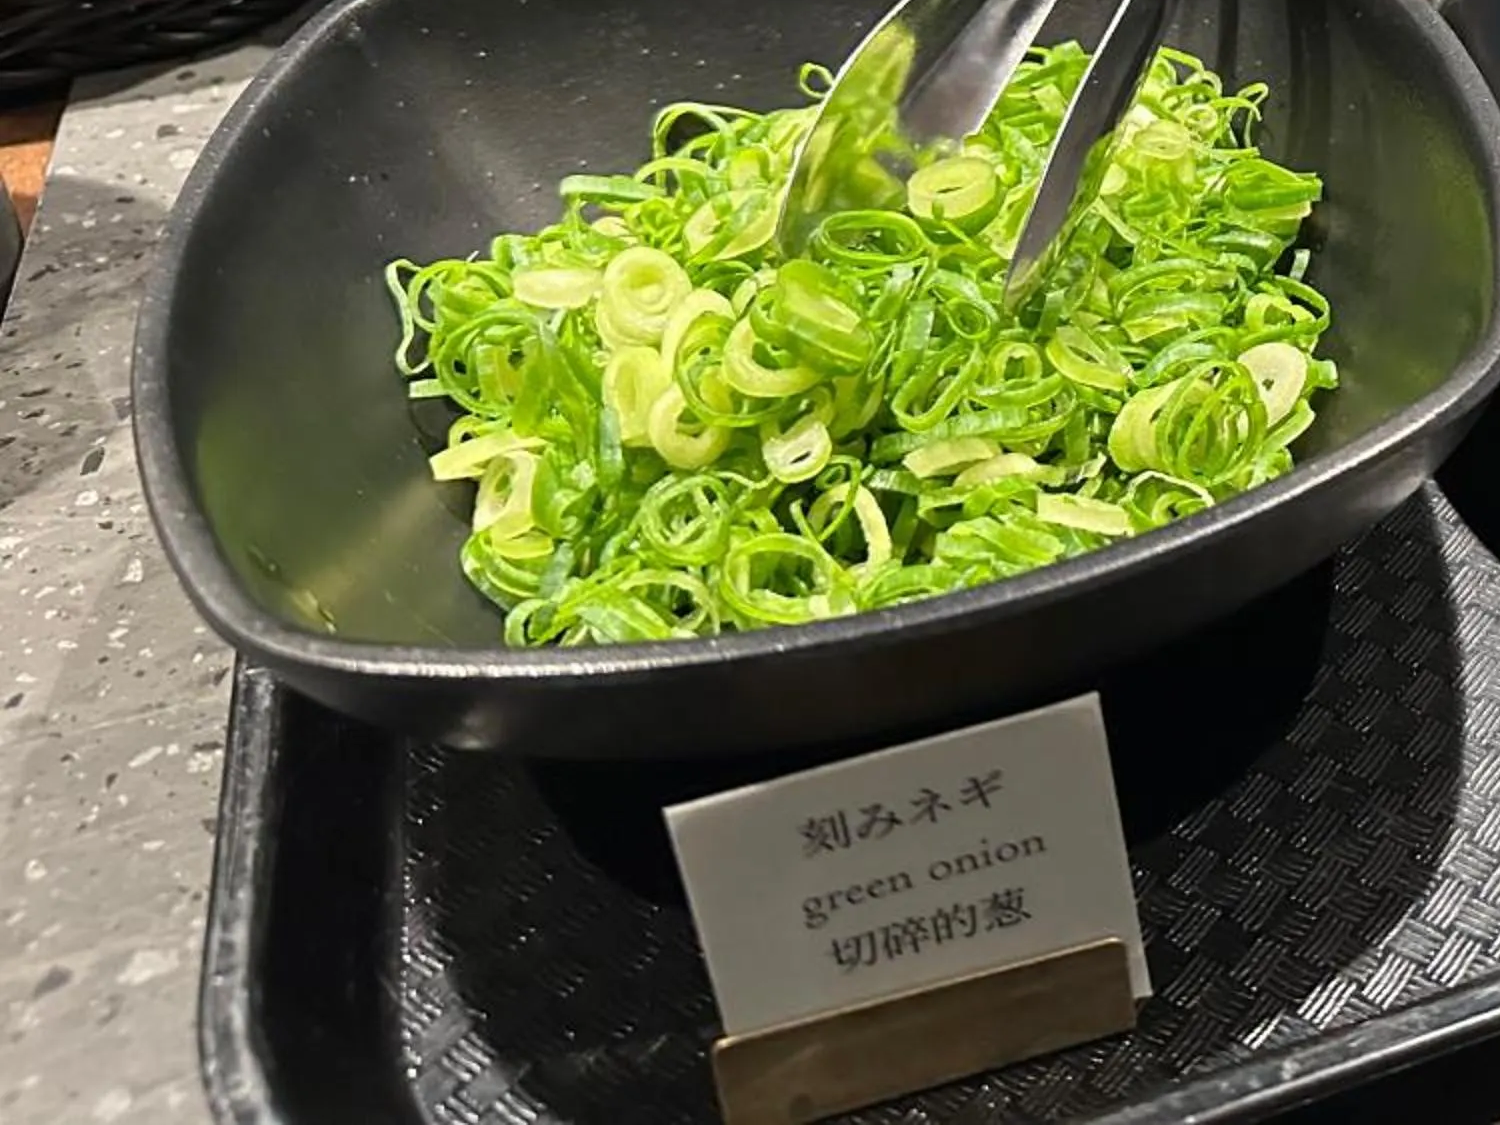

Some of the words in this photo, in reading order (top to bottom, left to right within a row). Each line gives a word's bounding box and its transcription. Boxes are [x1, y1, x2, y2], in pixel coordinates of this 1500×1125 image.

[799, 770, 1004, 859] 刻みネギ
[801, 870, 913, 930] green
[928, 834, 1048, 876] onion
[830, 888, 1033, 973] 切碎的葱
